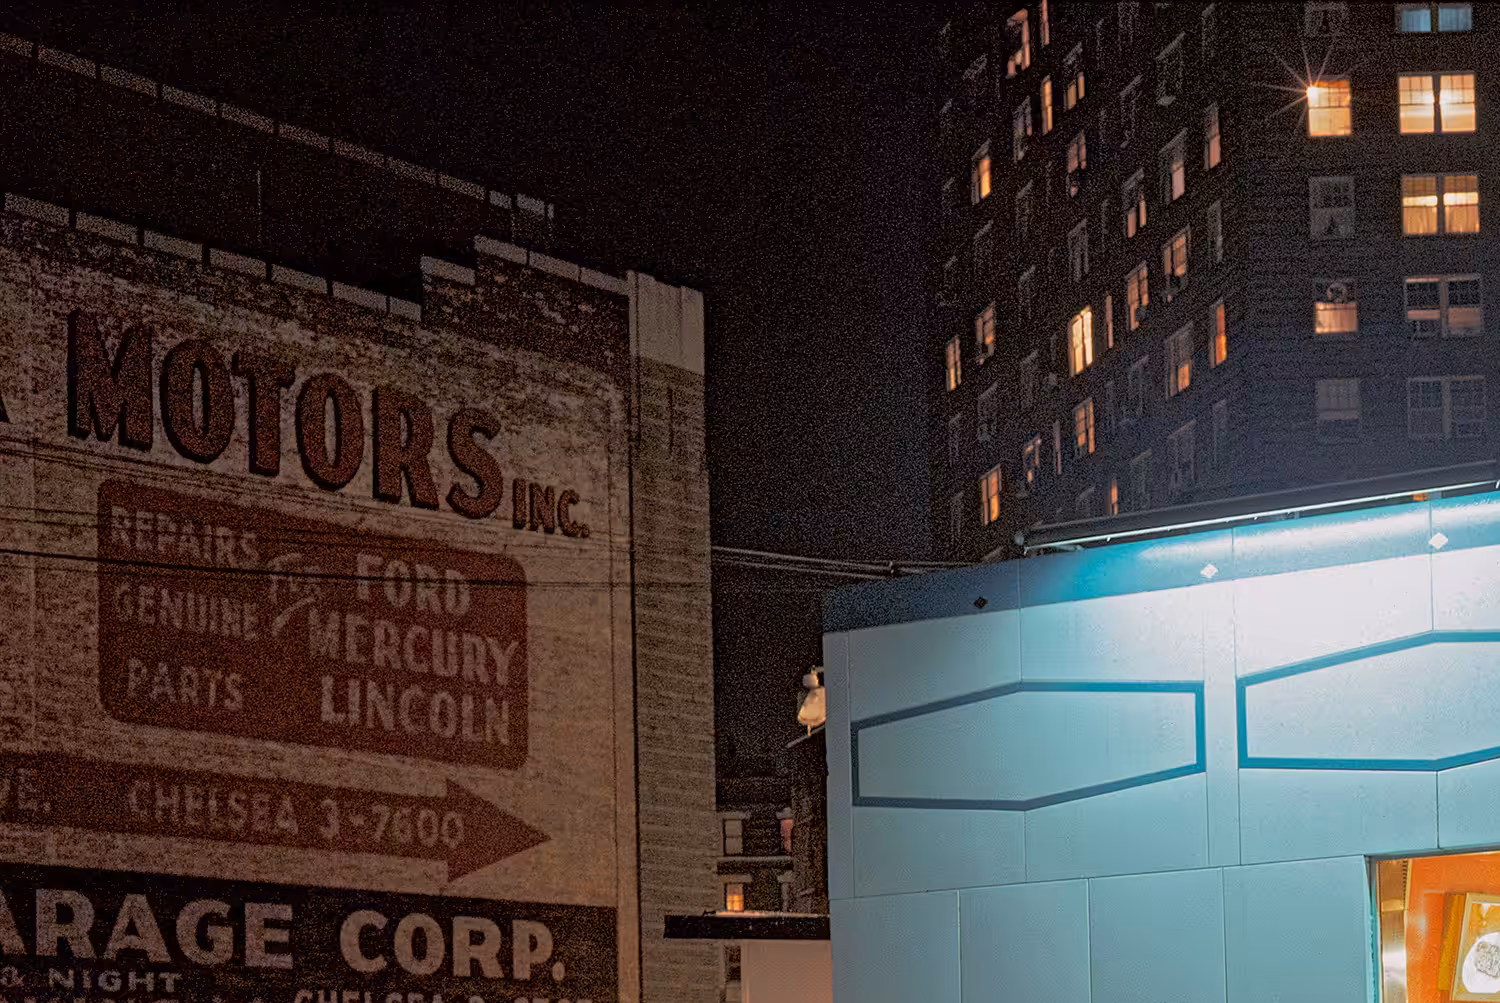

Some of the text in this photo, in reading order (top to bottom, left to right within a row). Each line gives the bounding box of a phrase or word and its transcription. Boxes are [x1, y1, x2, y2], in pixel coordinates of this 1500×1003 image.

[70, 308, 591, 538] MOTORS INC.
[110, 505, 260, 566] REPAIRS
[113, 583, 259, 642] GENUINE
[355, 550, 472, 616] FORD
[307, 606, 520, 687] MERCURY
[126, 658, 245, 712] PARTS
[320, 675, 511, 746] LINCOLN
[126, 779, 299, 836] CHELSEA
[319, 798, 466, 849] 3-7600
[338, 909, 567, 982] CORP.
[47, 967, 182, 993] NIGHT
